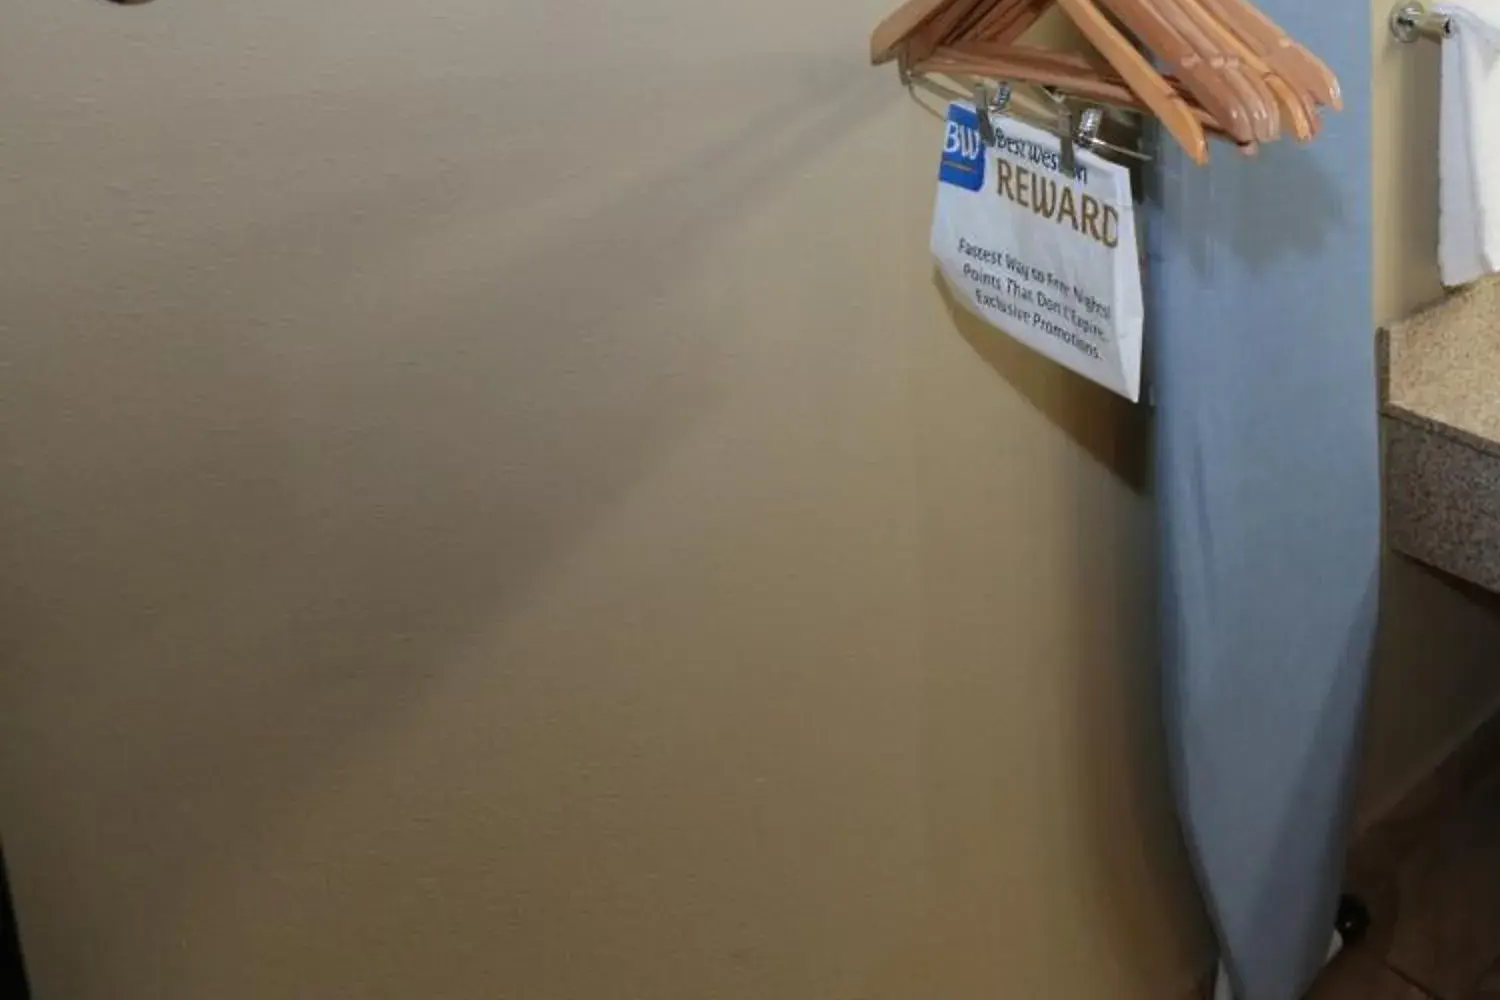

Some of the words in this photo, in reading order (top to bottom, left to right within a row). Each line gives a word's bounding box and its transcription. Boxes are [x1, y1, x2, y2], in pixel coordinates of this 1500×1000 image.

[944, 121, 980, 160] BW
[958, 237, 1002, 267] Fastest
[963, 263, 1002, 291] Points
[976, 288, 1031, 325] Exclusive
